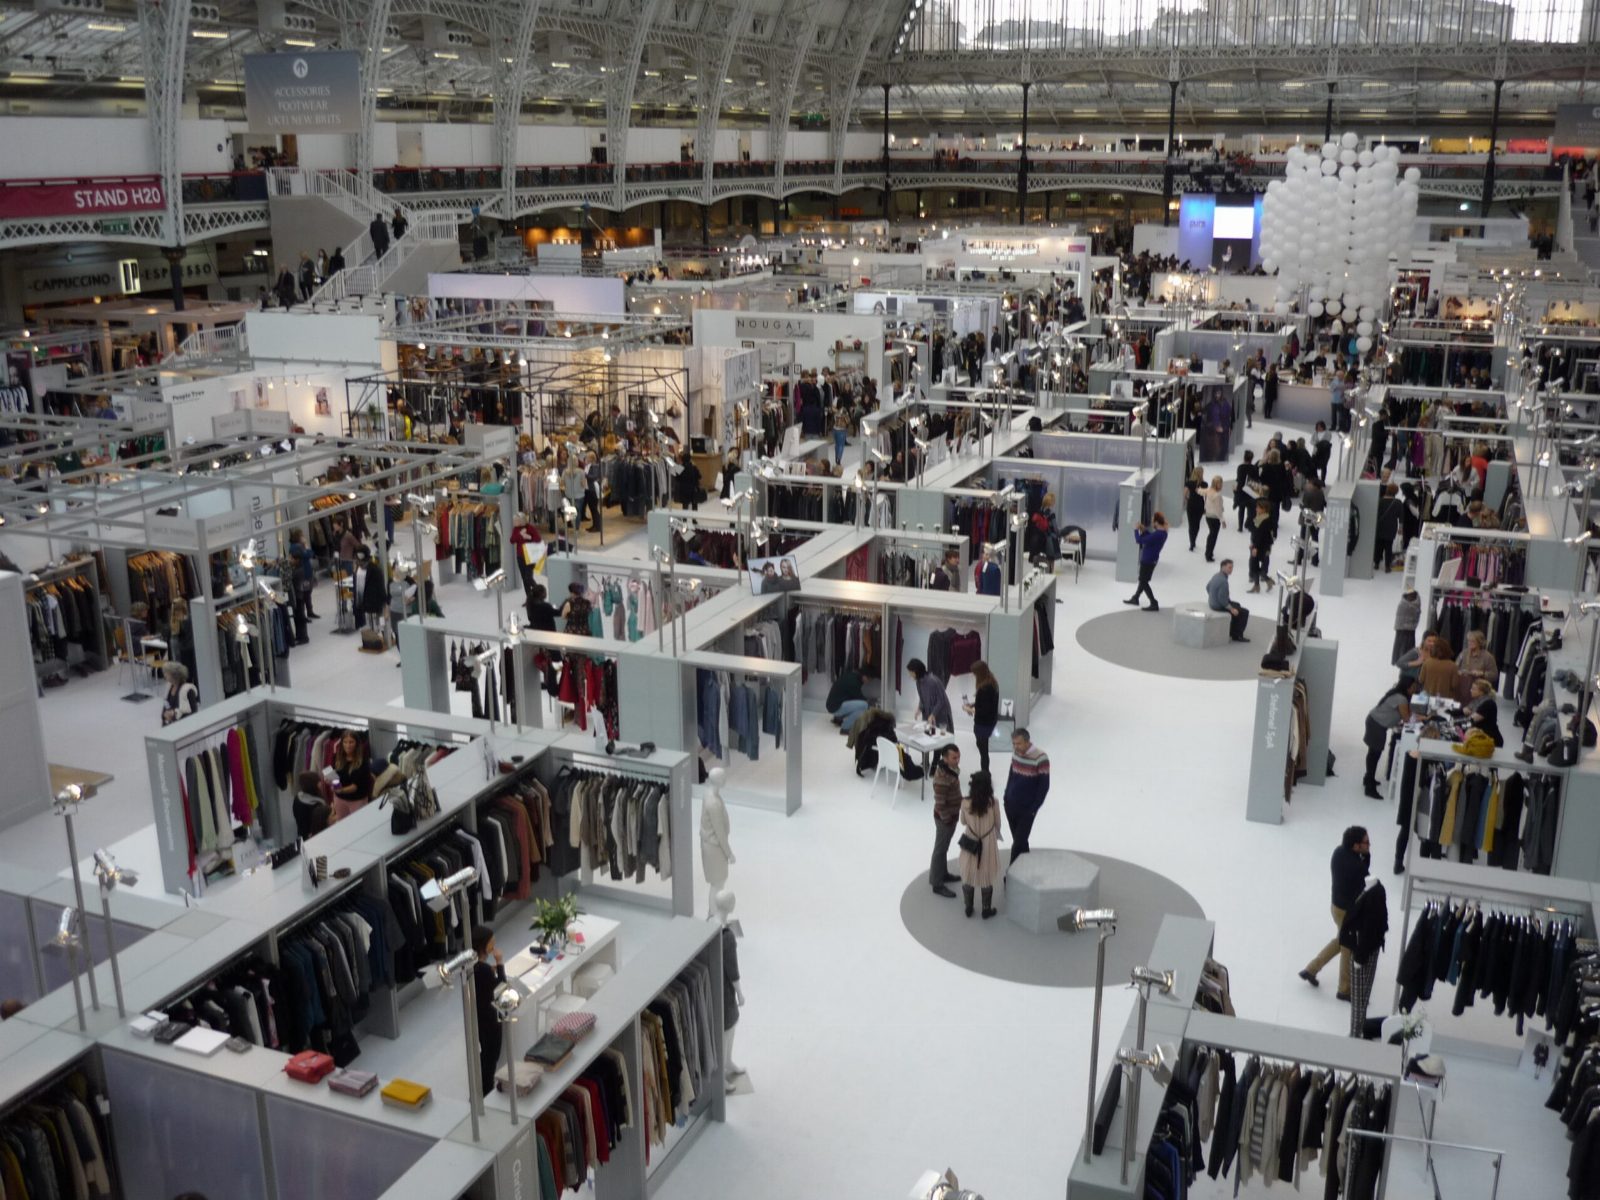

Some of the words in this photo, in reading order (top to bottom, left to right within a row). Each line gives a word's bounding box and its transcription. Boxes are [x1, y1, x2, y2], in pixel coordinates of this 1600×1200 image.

[274, 86, 331, 97] ACCESSORIES
[278, 101, 328, 111] FOOTWEAR
[292, 114, 313, 125] NEW
[315, 113, 341, 125] BRITS
[74, 189, 128, 208] STAND
[132, 186, 161, 205] H20
[33, 274, 111, 292] CAPPUCCINO
[144, 263, 212, 281] ESPSSO
[737, 320, 802, 329] NOUGAT
